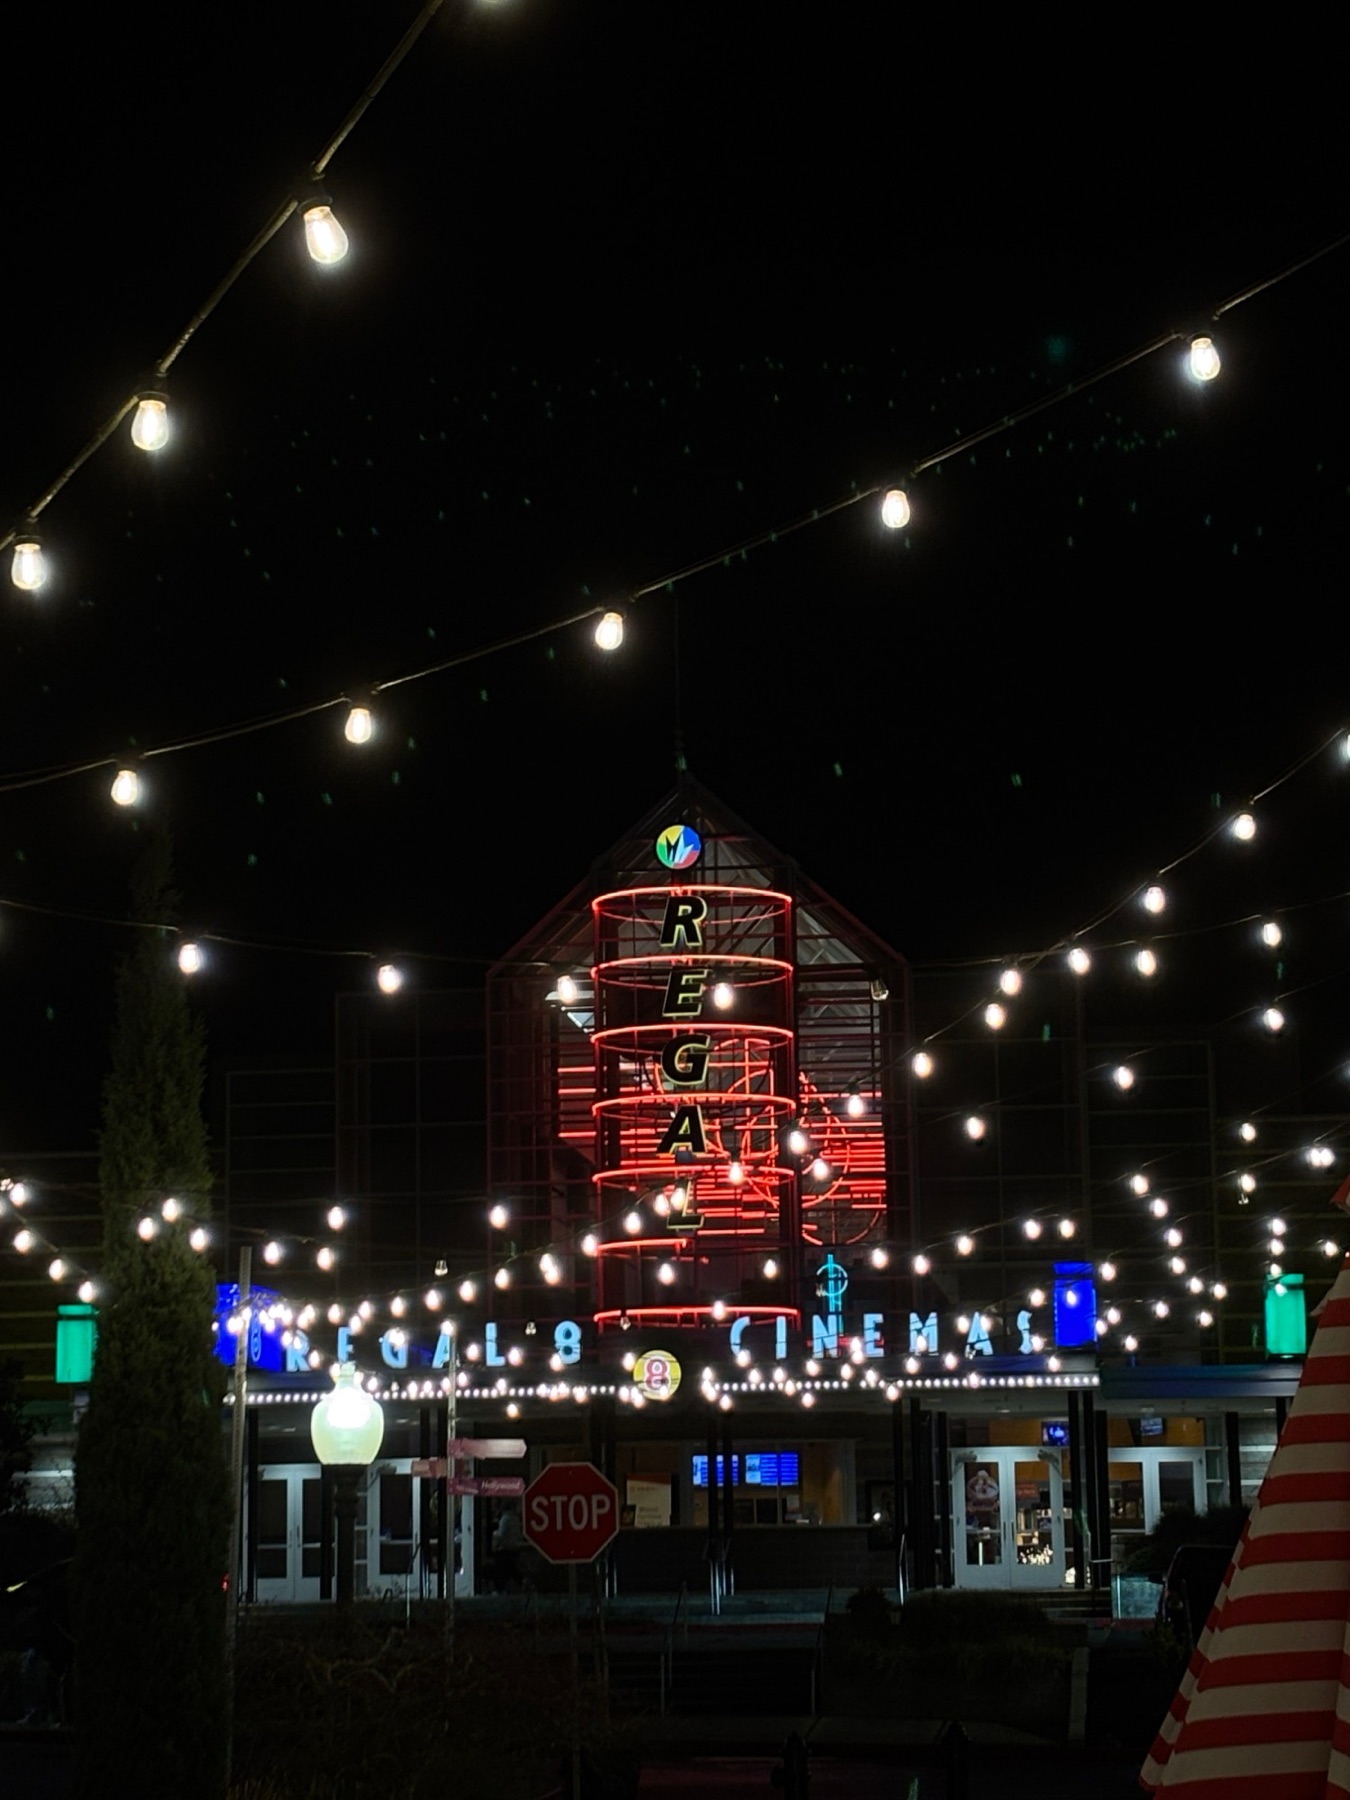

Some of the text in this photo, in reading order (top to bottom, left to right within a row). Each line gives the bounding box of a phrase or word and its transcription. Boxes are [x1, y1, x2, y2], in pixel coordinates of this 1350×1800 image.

[657, 894, 710, 1231] REGAL
[285, 1320, 583, 1373] REGAL 8
[729, 1309, 1033, 1360] CINEMAS
[644, 1356, 671, 1391] 8
[530, 1493, 612, 1533] STOP
